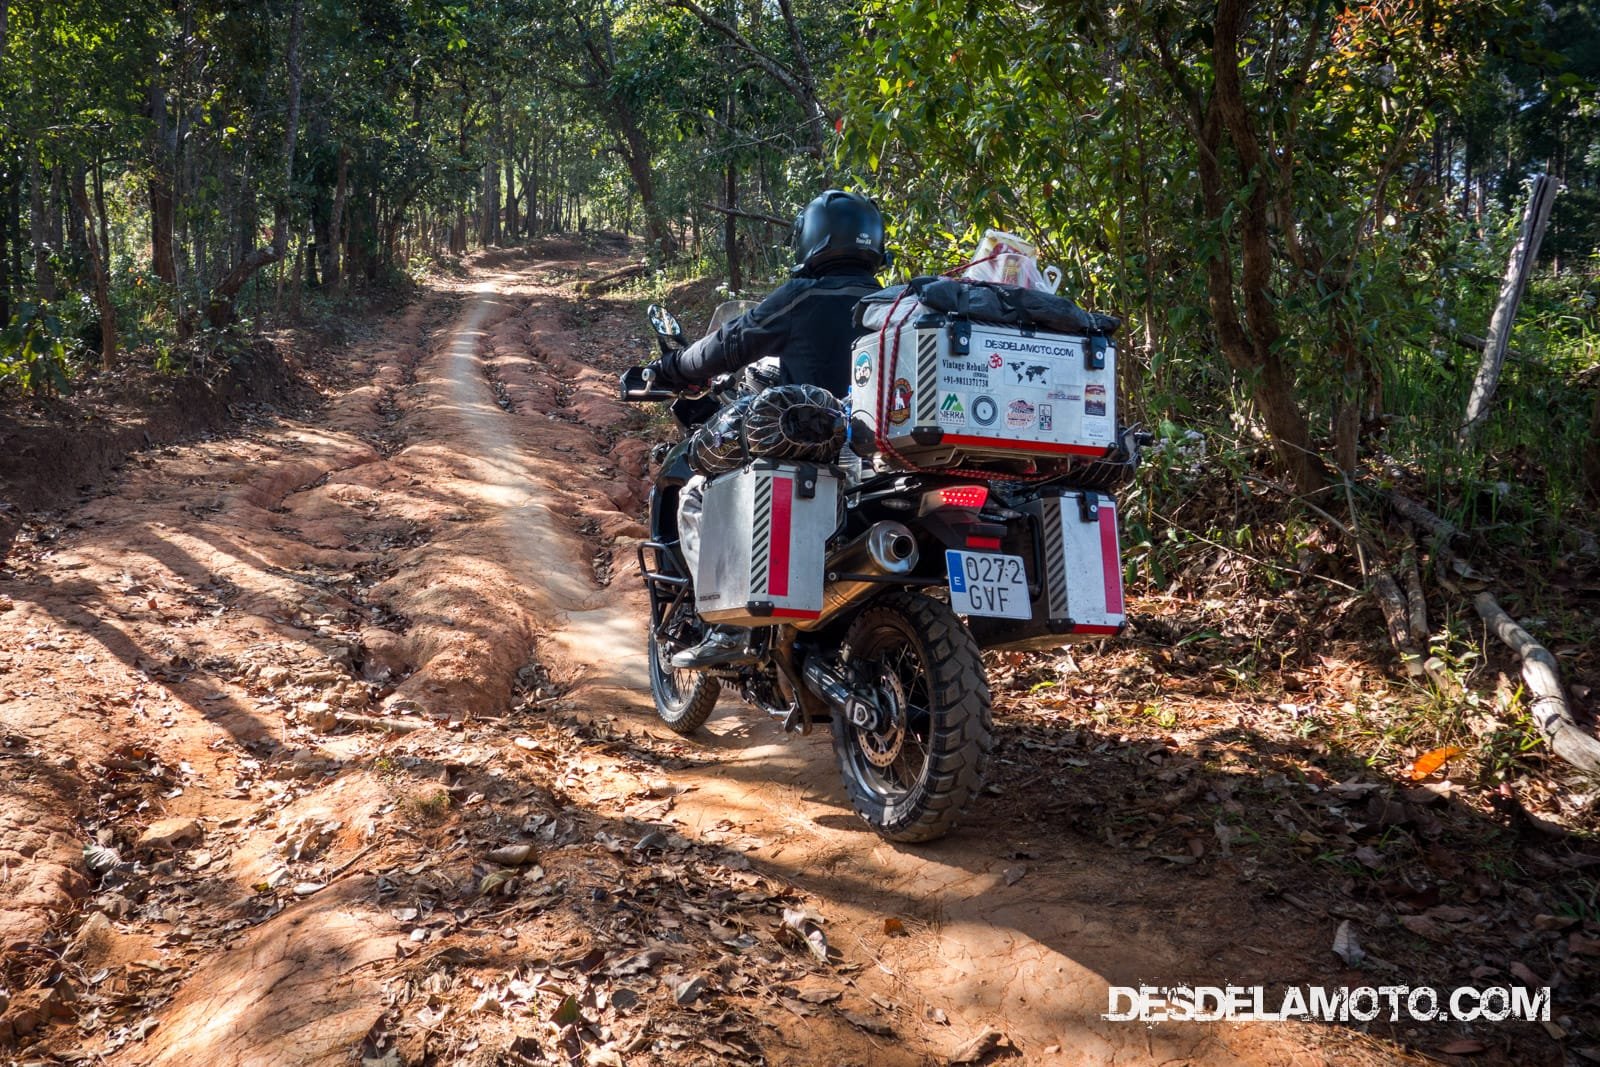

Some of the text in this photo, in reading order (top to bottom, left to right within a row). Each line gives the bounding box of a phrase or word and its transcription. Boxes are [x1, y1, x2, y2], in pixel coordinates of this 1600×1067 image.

[984, 339, 1074, 357] DESDELAMOTO.COM
[942, 359, 989, 373] Vintage Rebuild
[939, 409, 965, 419] SIERRA
[966, 556, 1023, 584] 0272
[954, 577, 961, 586] E
[969, 584, 1009, 612] GVF
